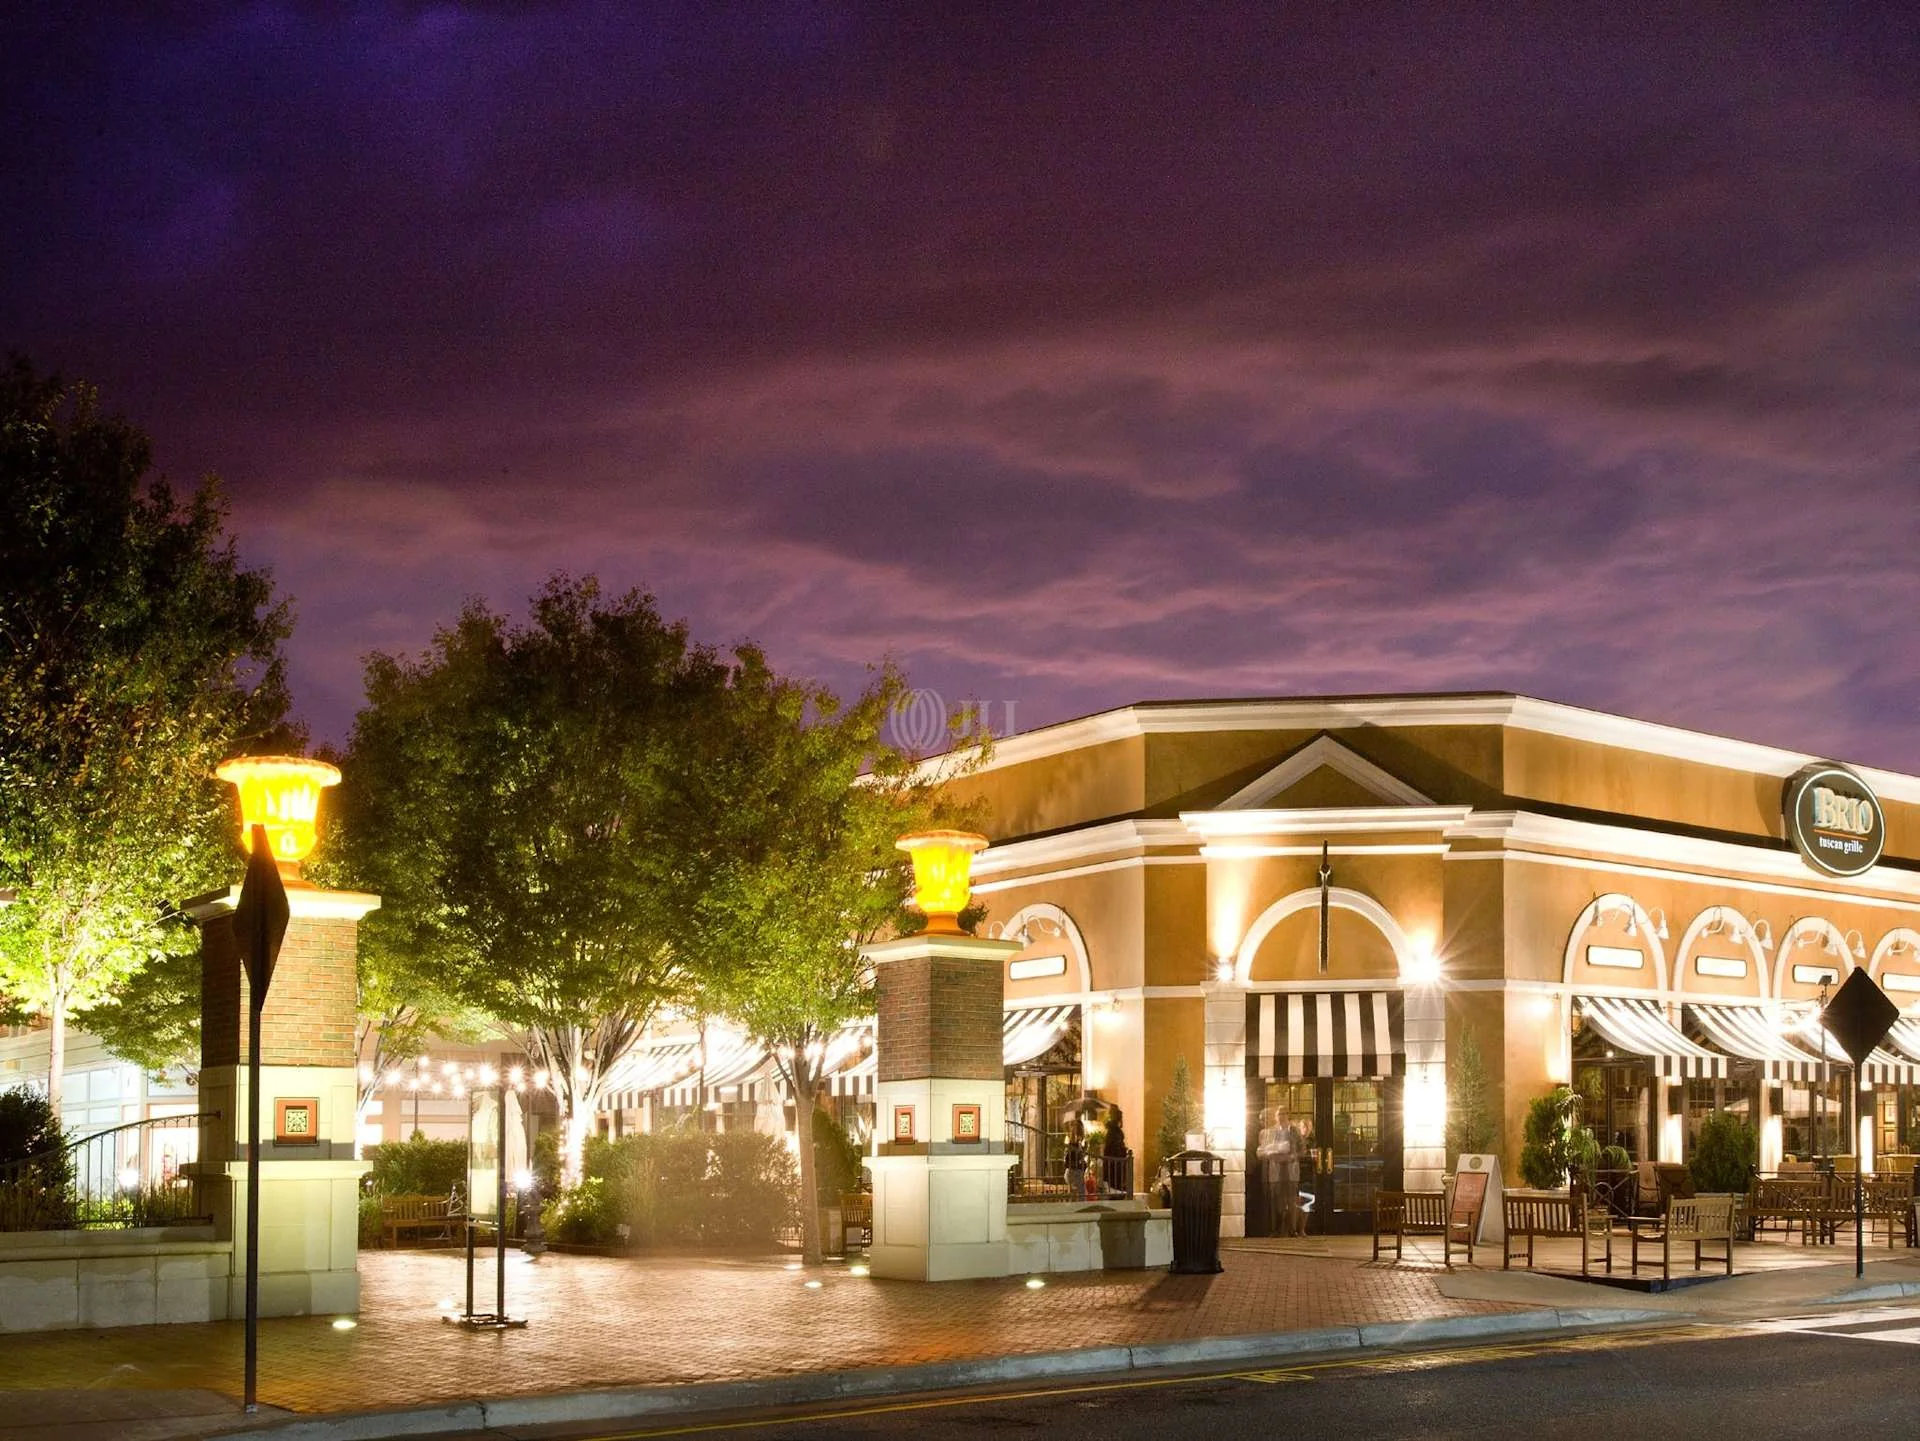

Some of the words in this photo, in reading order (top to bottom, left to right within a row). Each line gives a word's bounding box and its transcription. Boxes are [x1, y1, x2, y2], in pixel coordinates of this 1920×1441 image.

[1814, 787, 1873, 834] BRIO
[1819, 837, 1843, 850] tuscan
[1843, 840, 1863, 854] grille
